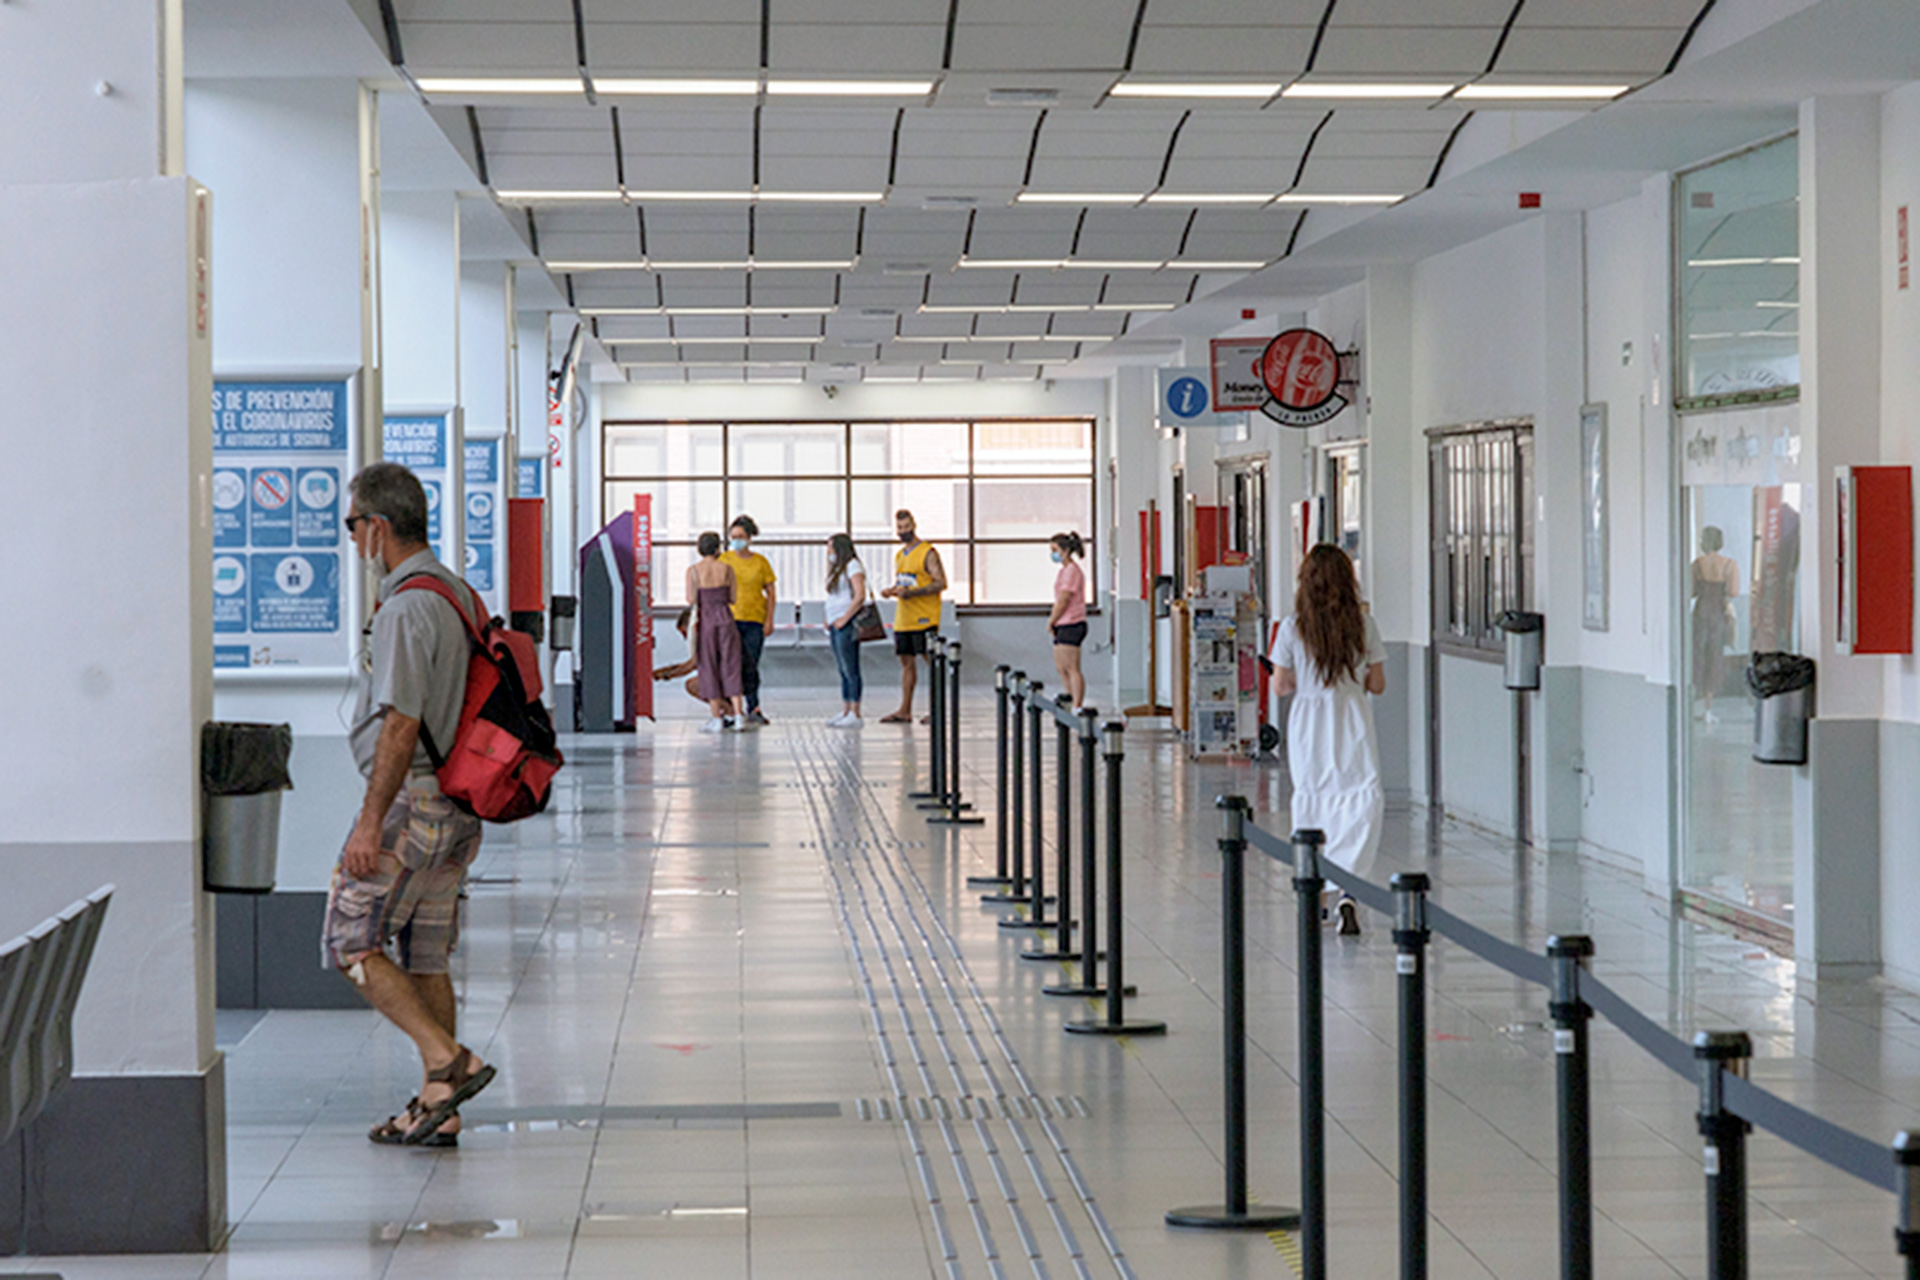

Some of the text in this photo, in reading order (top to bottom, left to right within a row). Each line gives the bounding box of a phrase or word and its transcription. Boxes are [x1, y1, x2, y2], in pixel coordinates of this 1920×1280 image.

[225, 391, 242, 410] DE
[246, 388, 334, 410] PREVENCIÓN
[223, 411, 237, 430] EL
[241, 411, 334, 431] CORONAVIRUS
[635, 515, 649, 573] Billetes
